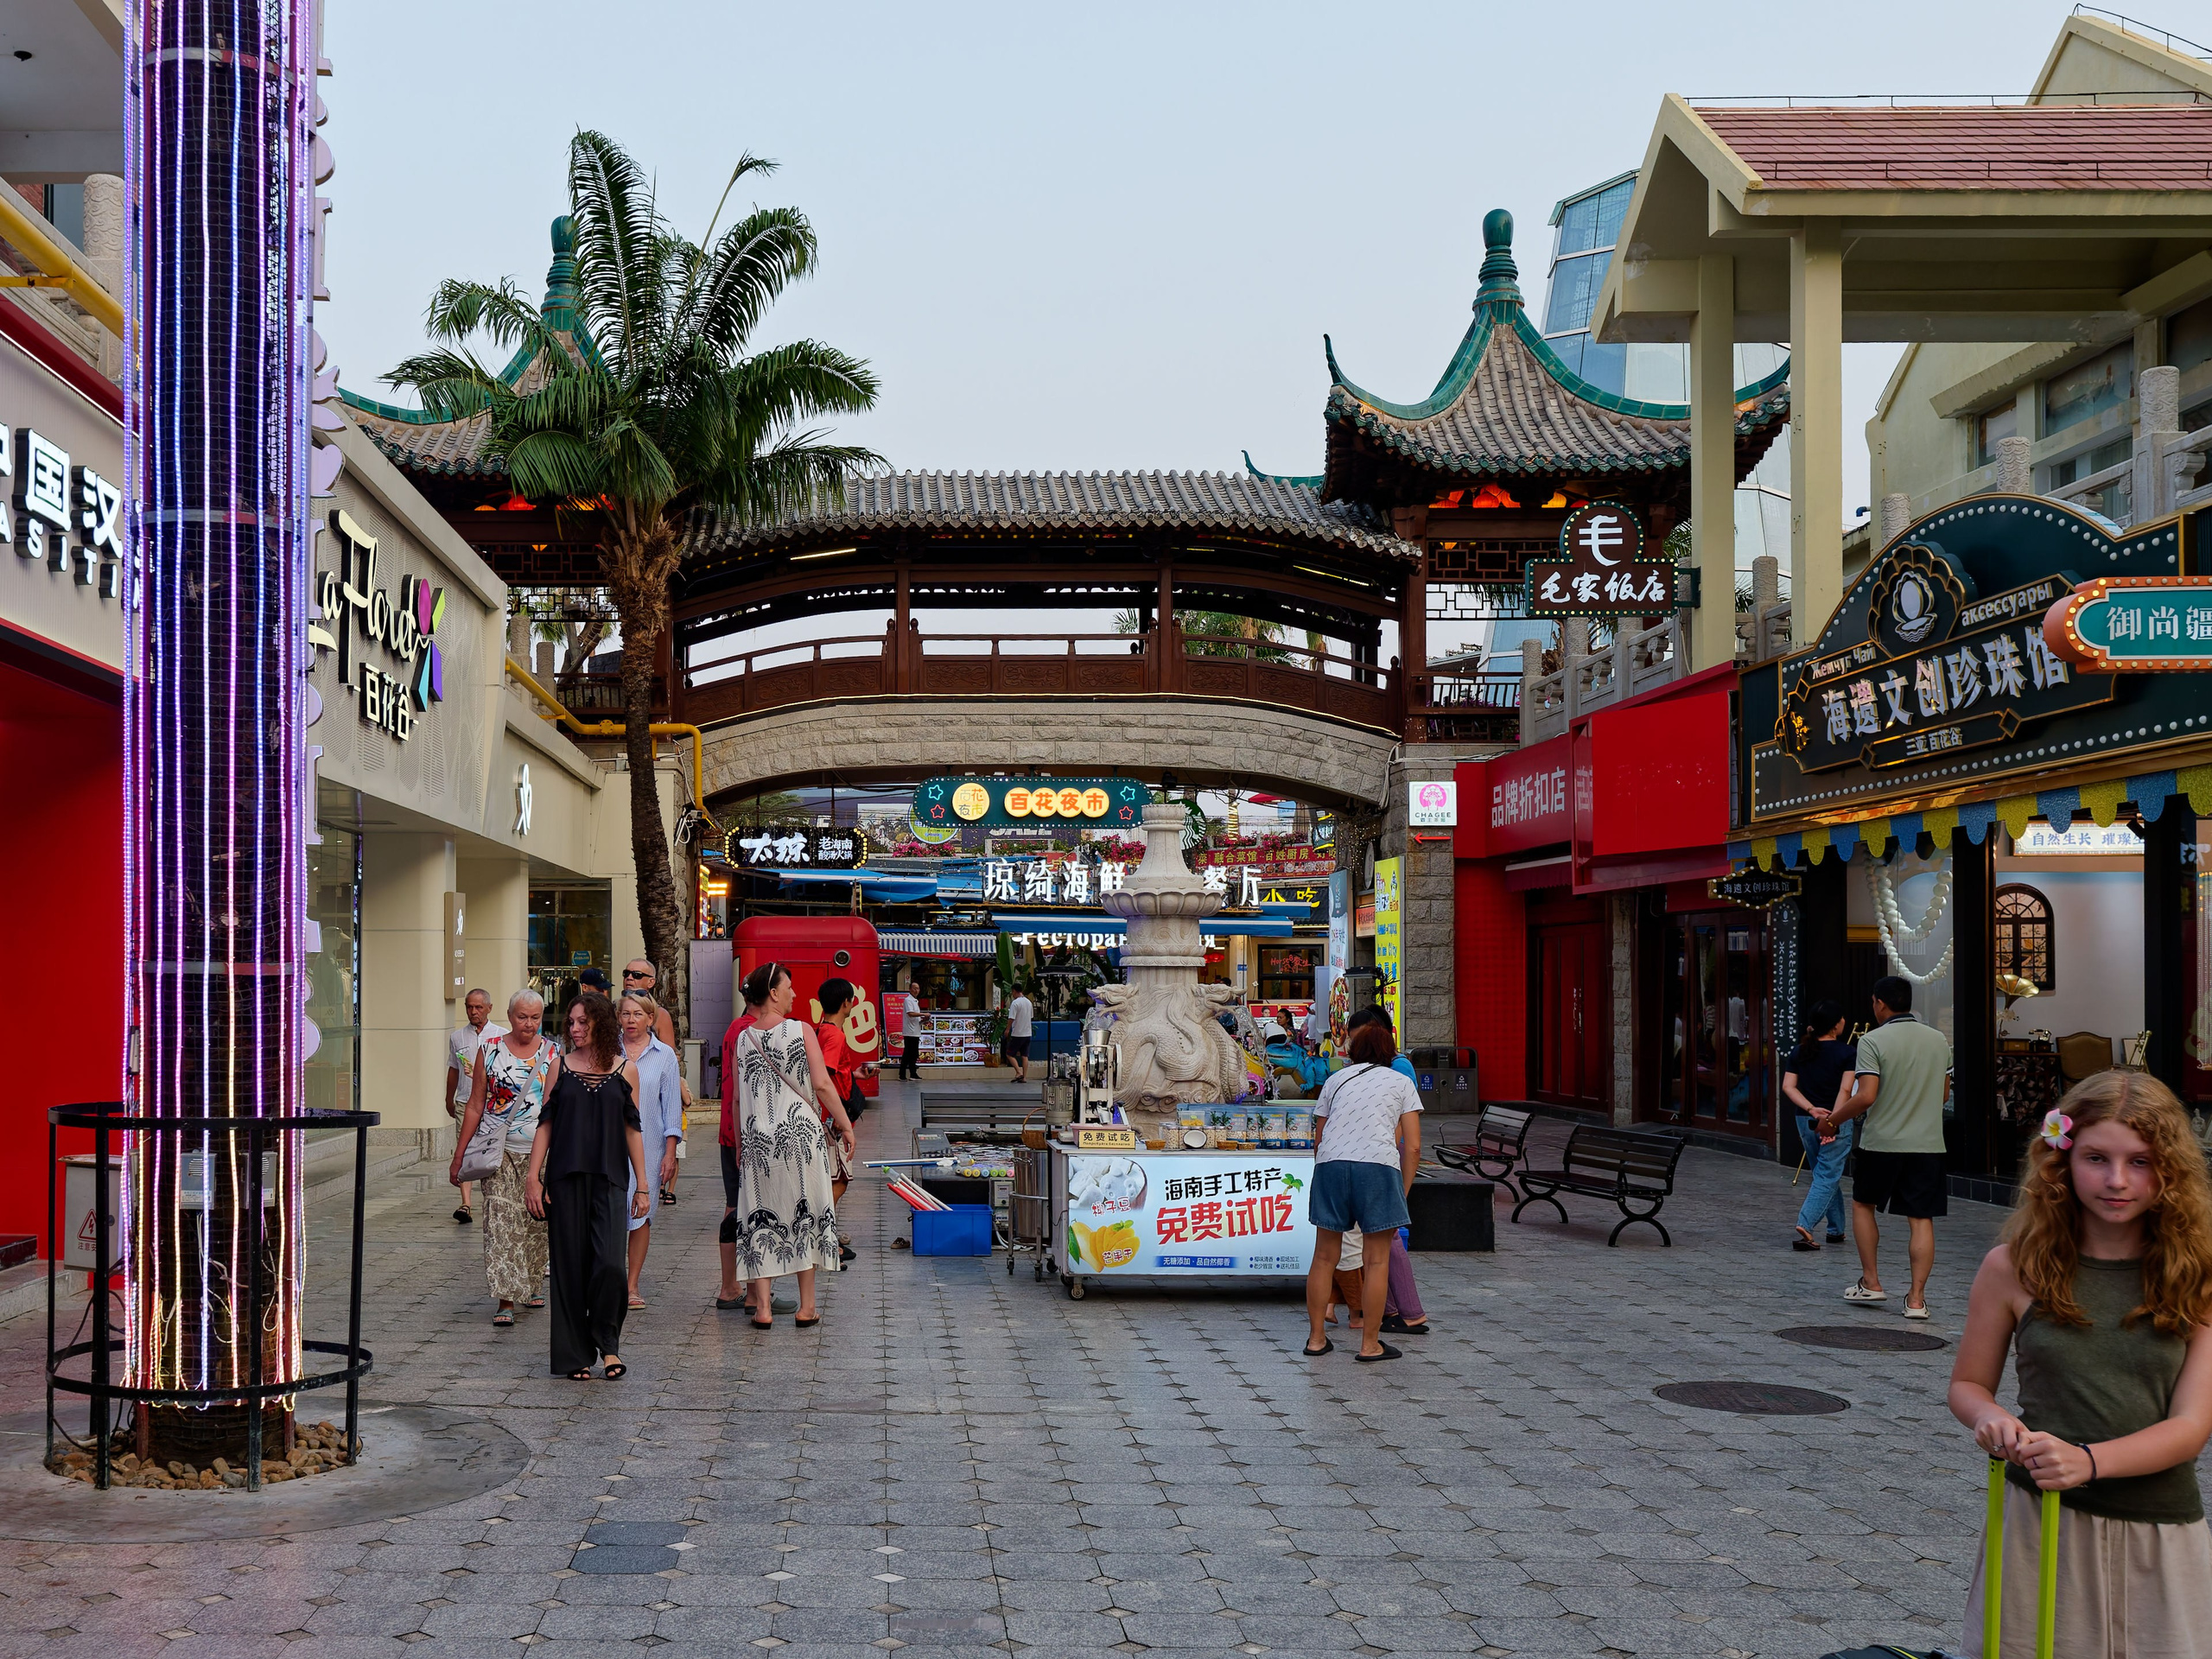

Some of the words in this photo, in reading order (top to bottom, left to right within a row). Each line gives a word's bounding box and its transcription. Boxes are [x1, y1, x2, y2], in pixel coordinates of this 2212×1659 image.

[1540, 569, 1666, 603] 毛家饭店
[1961, 582, 2054, 626] аксессуары
[1811, 655, 1852, 679] Жемчуг
[1853, 644, 1877, 664] Чай
[1821, 621, 2070, 745] 海遗文创珍珠馆
[365, 662, 410, 741] 百花谷
[1009, 792, 1104, 812] 百花夜市
[1491, 766, 1566, 829] 品牌折扣店
[817, 850, 853, 861] 酸汤火锅
[819, 836, 853, 850] 老海南
[1214, 850, 1258, 864] 融合菜馆
[1265, 849, 1310, 861] 百姓厨房
[2032, 832, 2092, 847] 自然生长
[1083, 1132, 1130, 1142] 免费试吃
[1165, 1167, 1282, 1201] 海南手工特产
[1156, 1194, 1294, 1245] 免费试吃
[78, 1242, 97, 1252] 注意安
